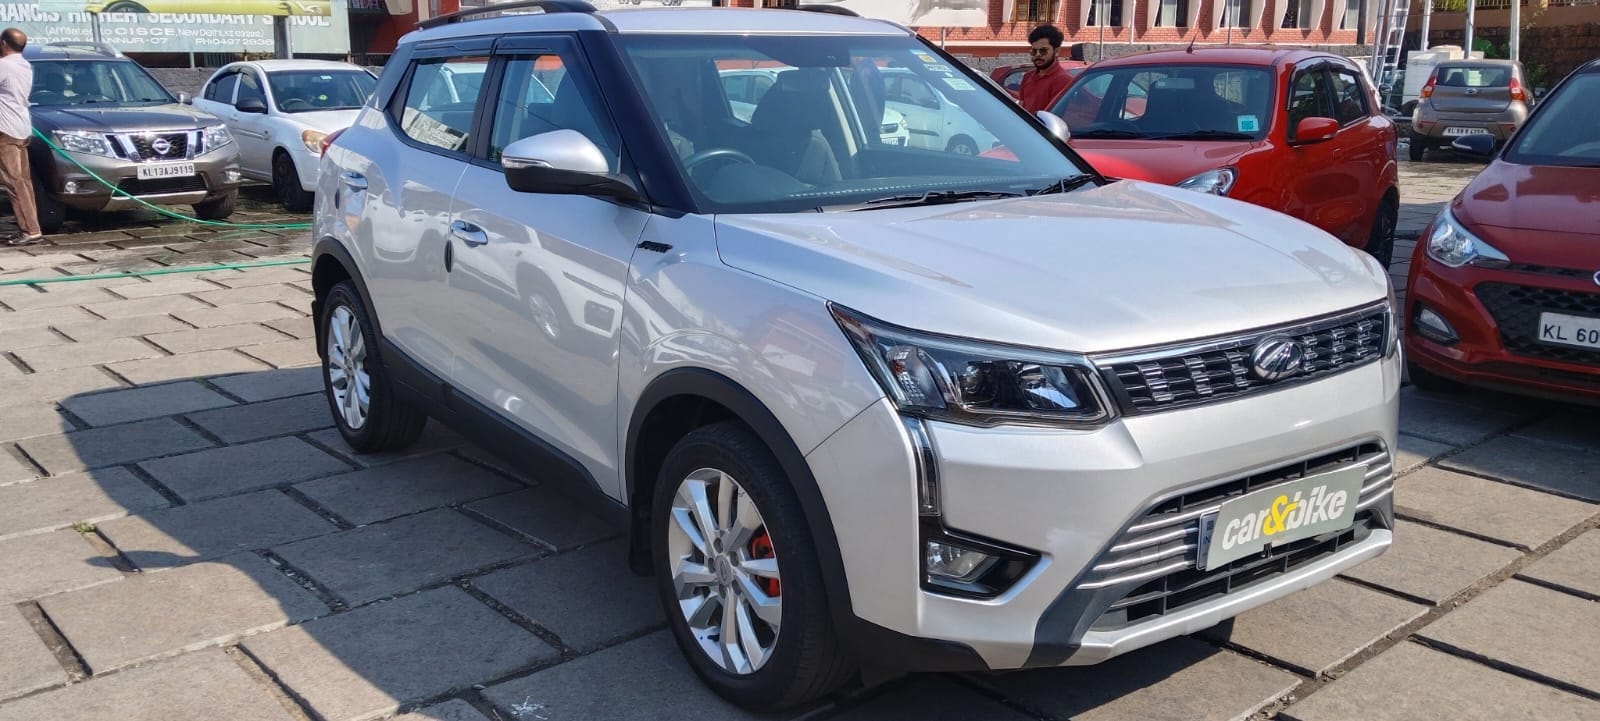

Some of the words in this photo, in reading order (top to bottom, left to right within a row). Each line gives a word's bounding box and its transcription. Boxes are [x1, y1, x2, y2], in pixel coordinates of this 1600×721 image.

[142, 164, 194, 177] KL13AJ9119
[1543, 323, 1568, 340] KL
[1576, 327, 1599, 344] 60
[1222, 485, 1347, 550] car&bike
